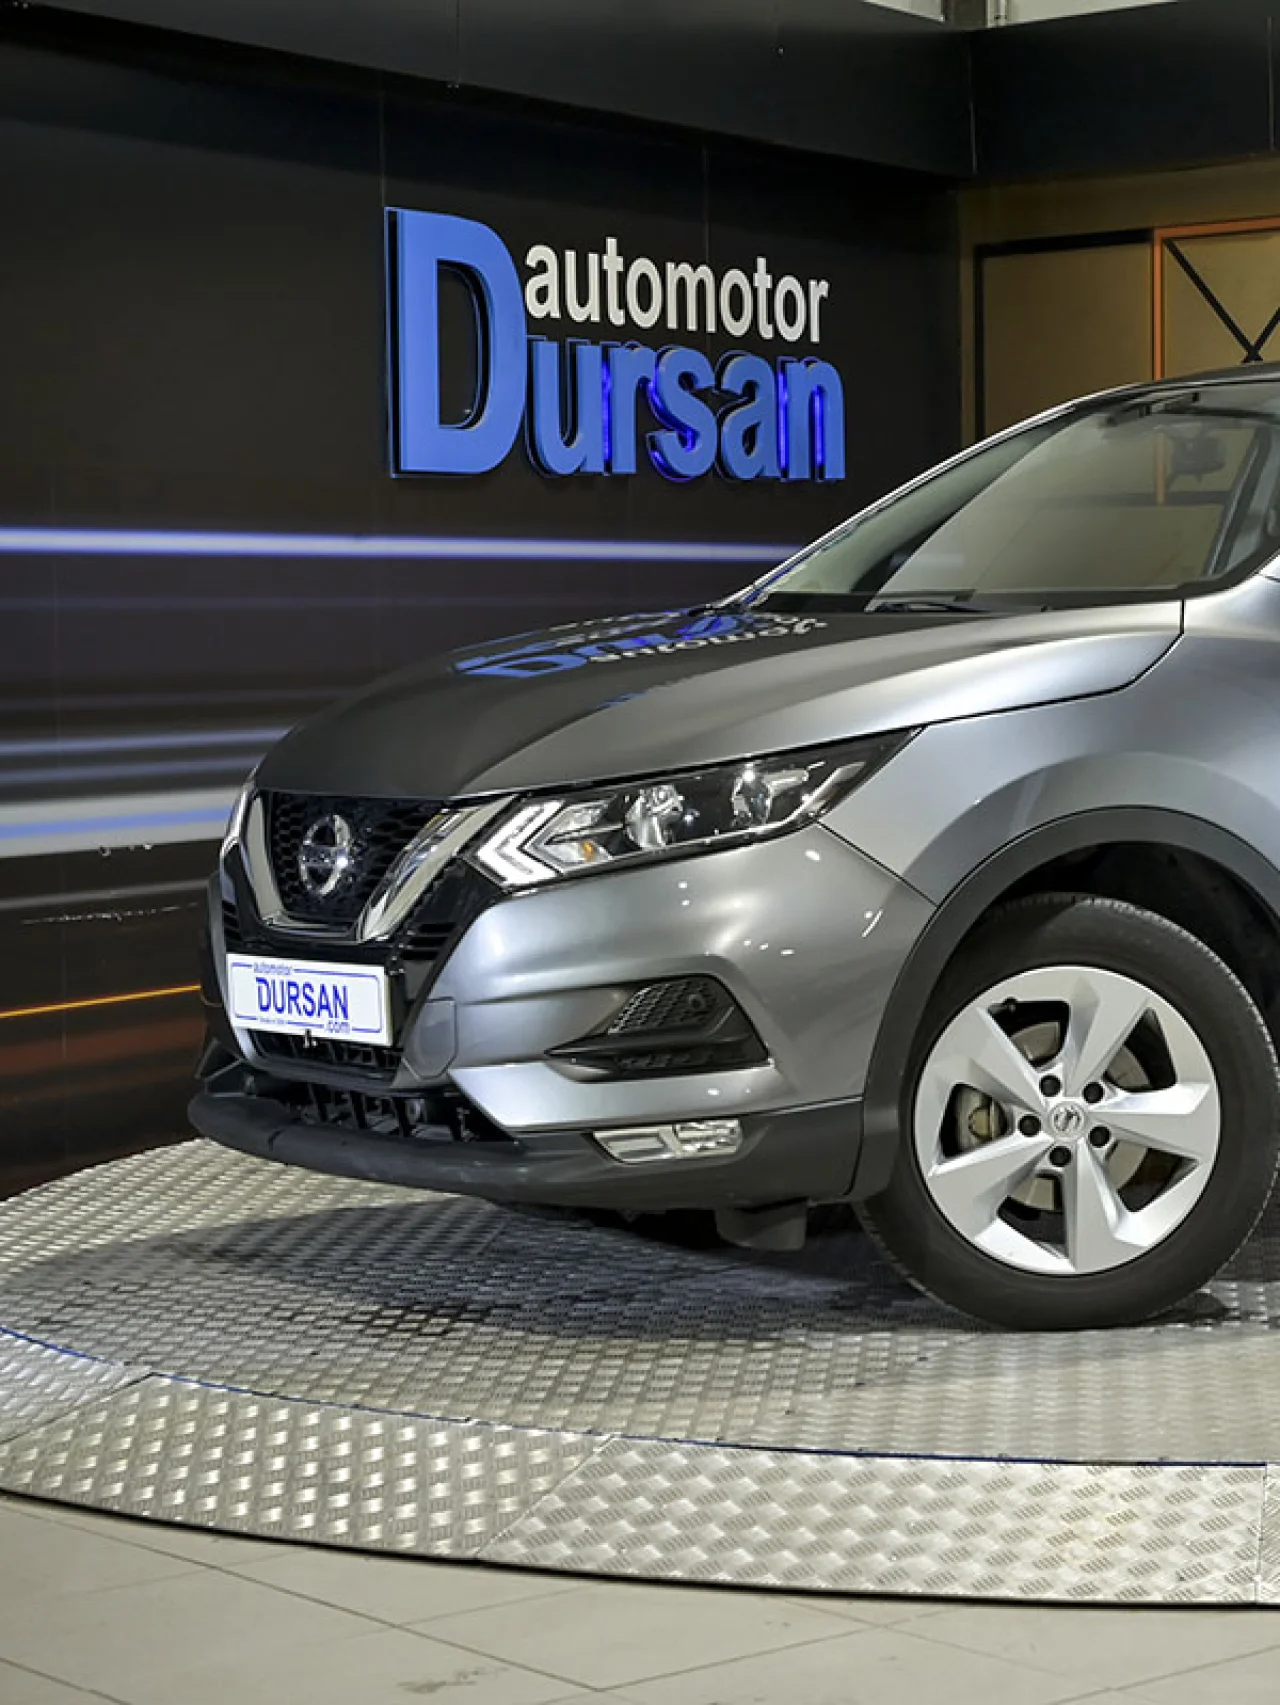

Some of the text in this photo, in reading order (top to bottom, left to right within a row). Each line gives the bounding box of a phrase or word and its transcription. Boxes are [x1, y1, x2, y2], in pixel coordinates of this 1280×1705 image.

[525, 236, 829, 342] automotor
[385, 207, 845, 482] Dursan
[256, 977, 349, 1020] DURSAN
